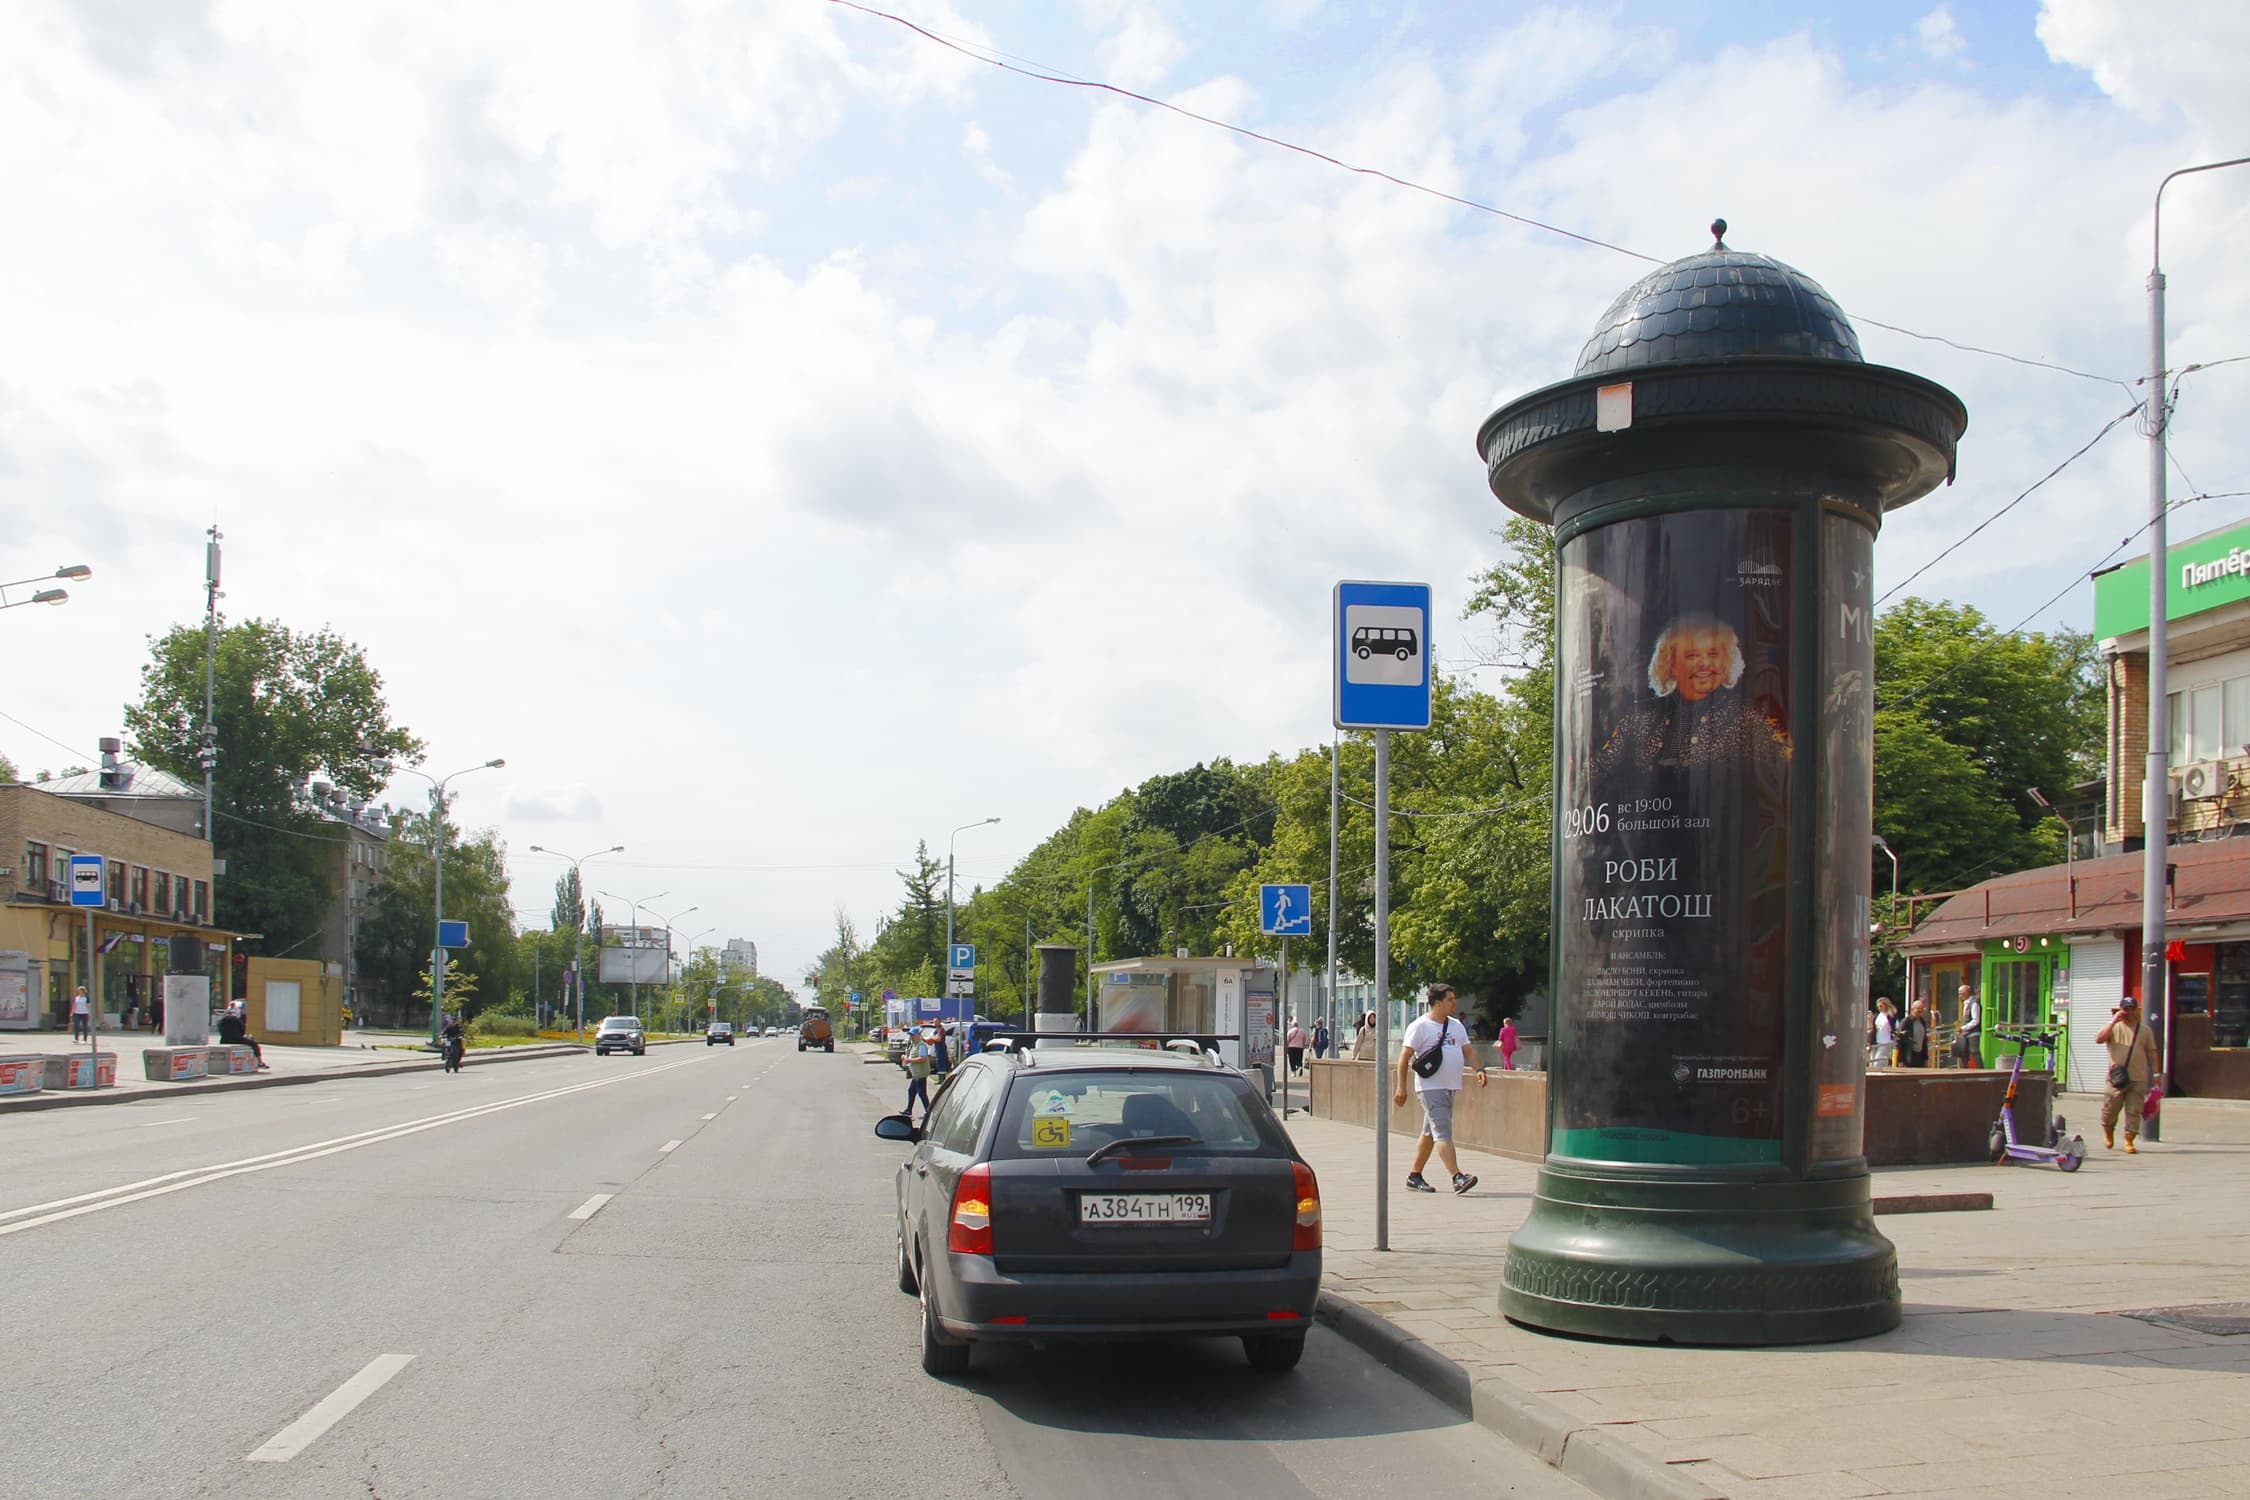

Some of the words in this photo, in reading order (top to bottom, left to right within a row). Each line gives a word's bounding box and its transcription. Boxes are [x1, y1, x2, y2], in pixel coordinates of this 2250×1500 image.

[1564, 803, 1610, 839] 29.06
[1617, 803, 1632, 814] вс
[1635, 797, 1672, 813] 19:00
[1617, 815, 1680, 832] большой
[1684, 817, 1710, 829] зал
[1605, 857, 1679, 884] РОБИ
[1583, 894, 1713, 921] ЛАКАТОШ
[1612, 928, 1665, 942] скрипка
[956, 947, 970, 966] P
[1697, 1068, 1768, 1079] ГАЗПРОМБАНК
[1731, 1098, 1769, 1124] 6+
[1088, 1198, 1170, 1219] А384ТН
[1175, 1196, 1205, 1212] 199
